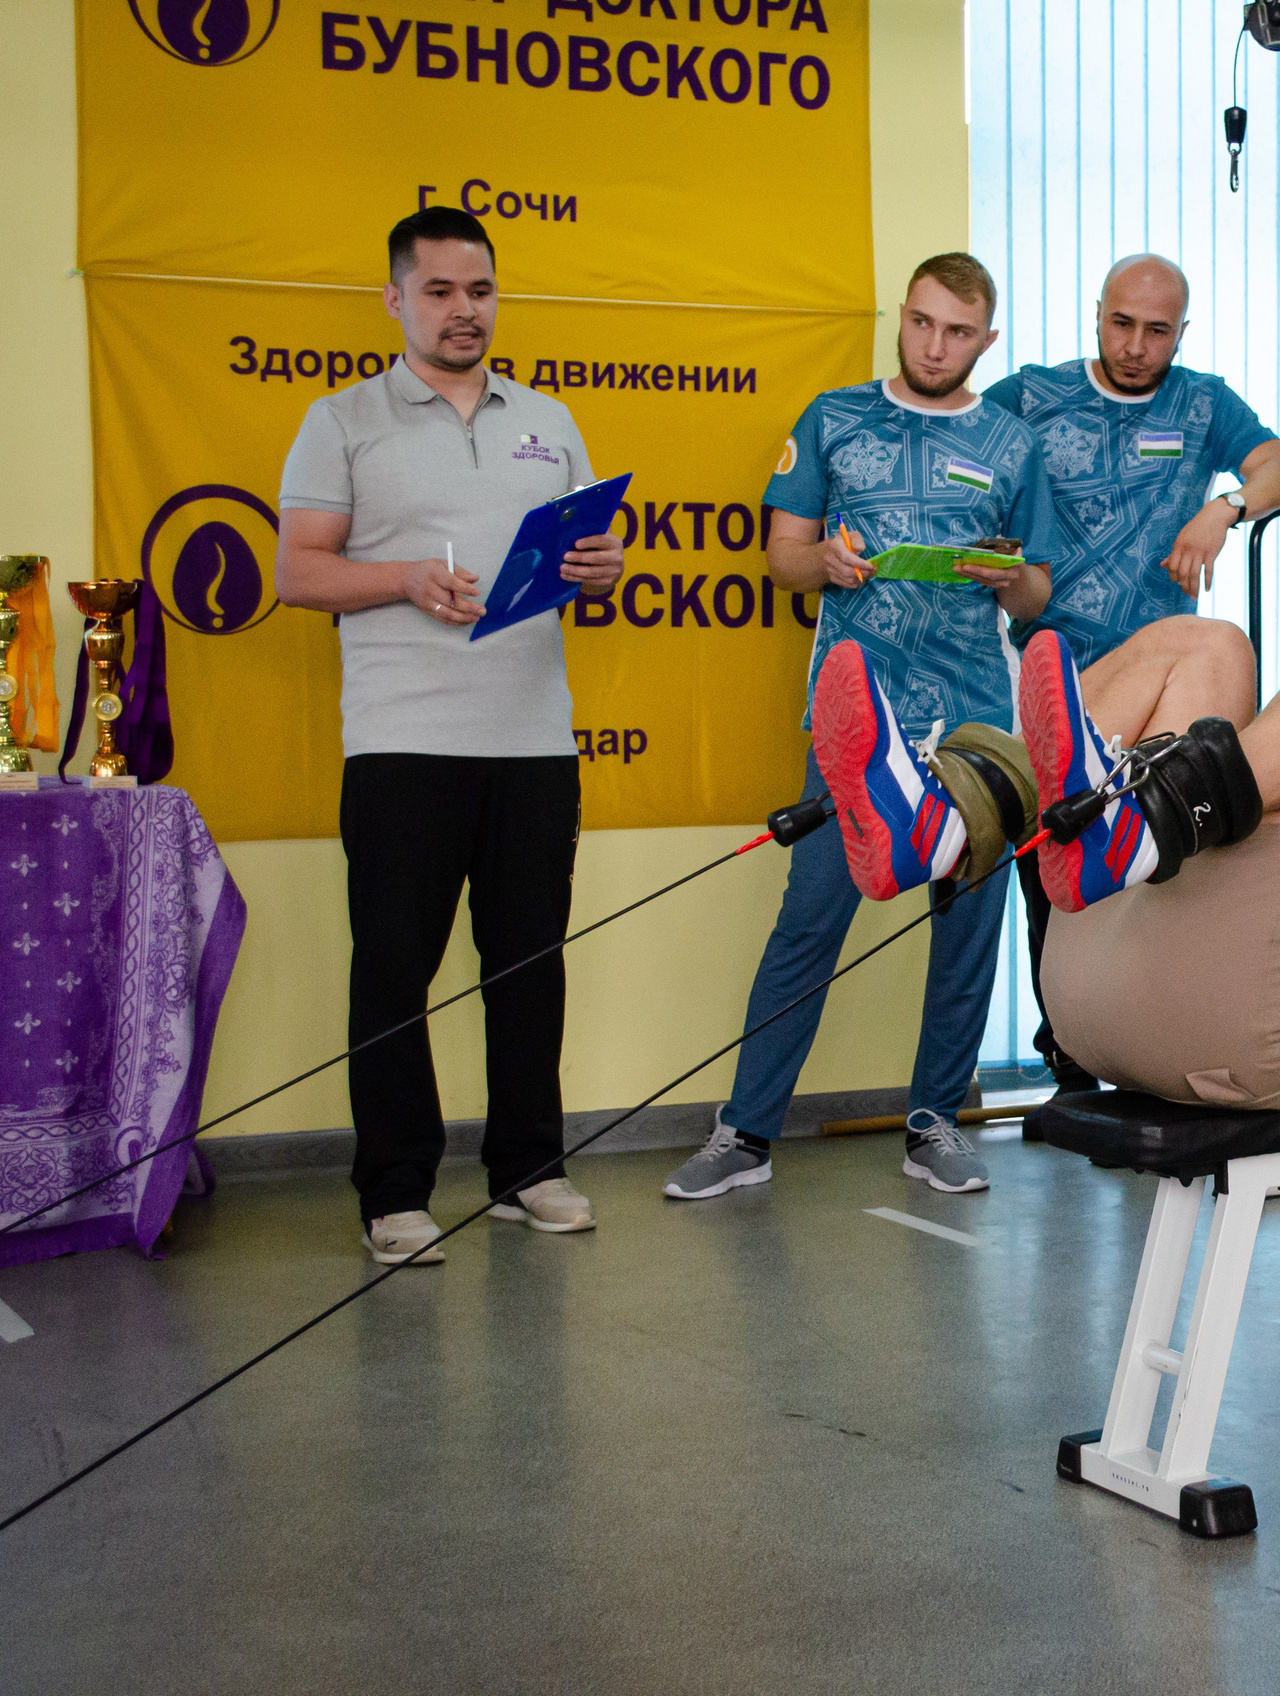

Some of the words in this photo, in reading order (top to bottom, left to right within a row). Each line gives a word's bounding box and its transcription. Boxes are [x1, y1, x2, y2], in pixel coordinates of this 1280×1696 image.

[320, 12, 831, 110] БУБНОВСКОГО
[461, 179, 577, 222] Сочи
[229, 335, 404, 387] Здоро
[530, 359, 757, 393] движении
[512, 451, 559, 465] ЗДОРОВЬЯ
[572, 728, 647, 764] дар
